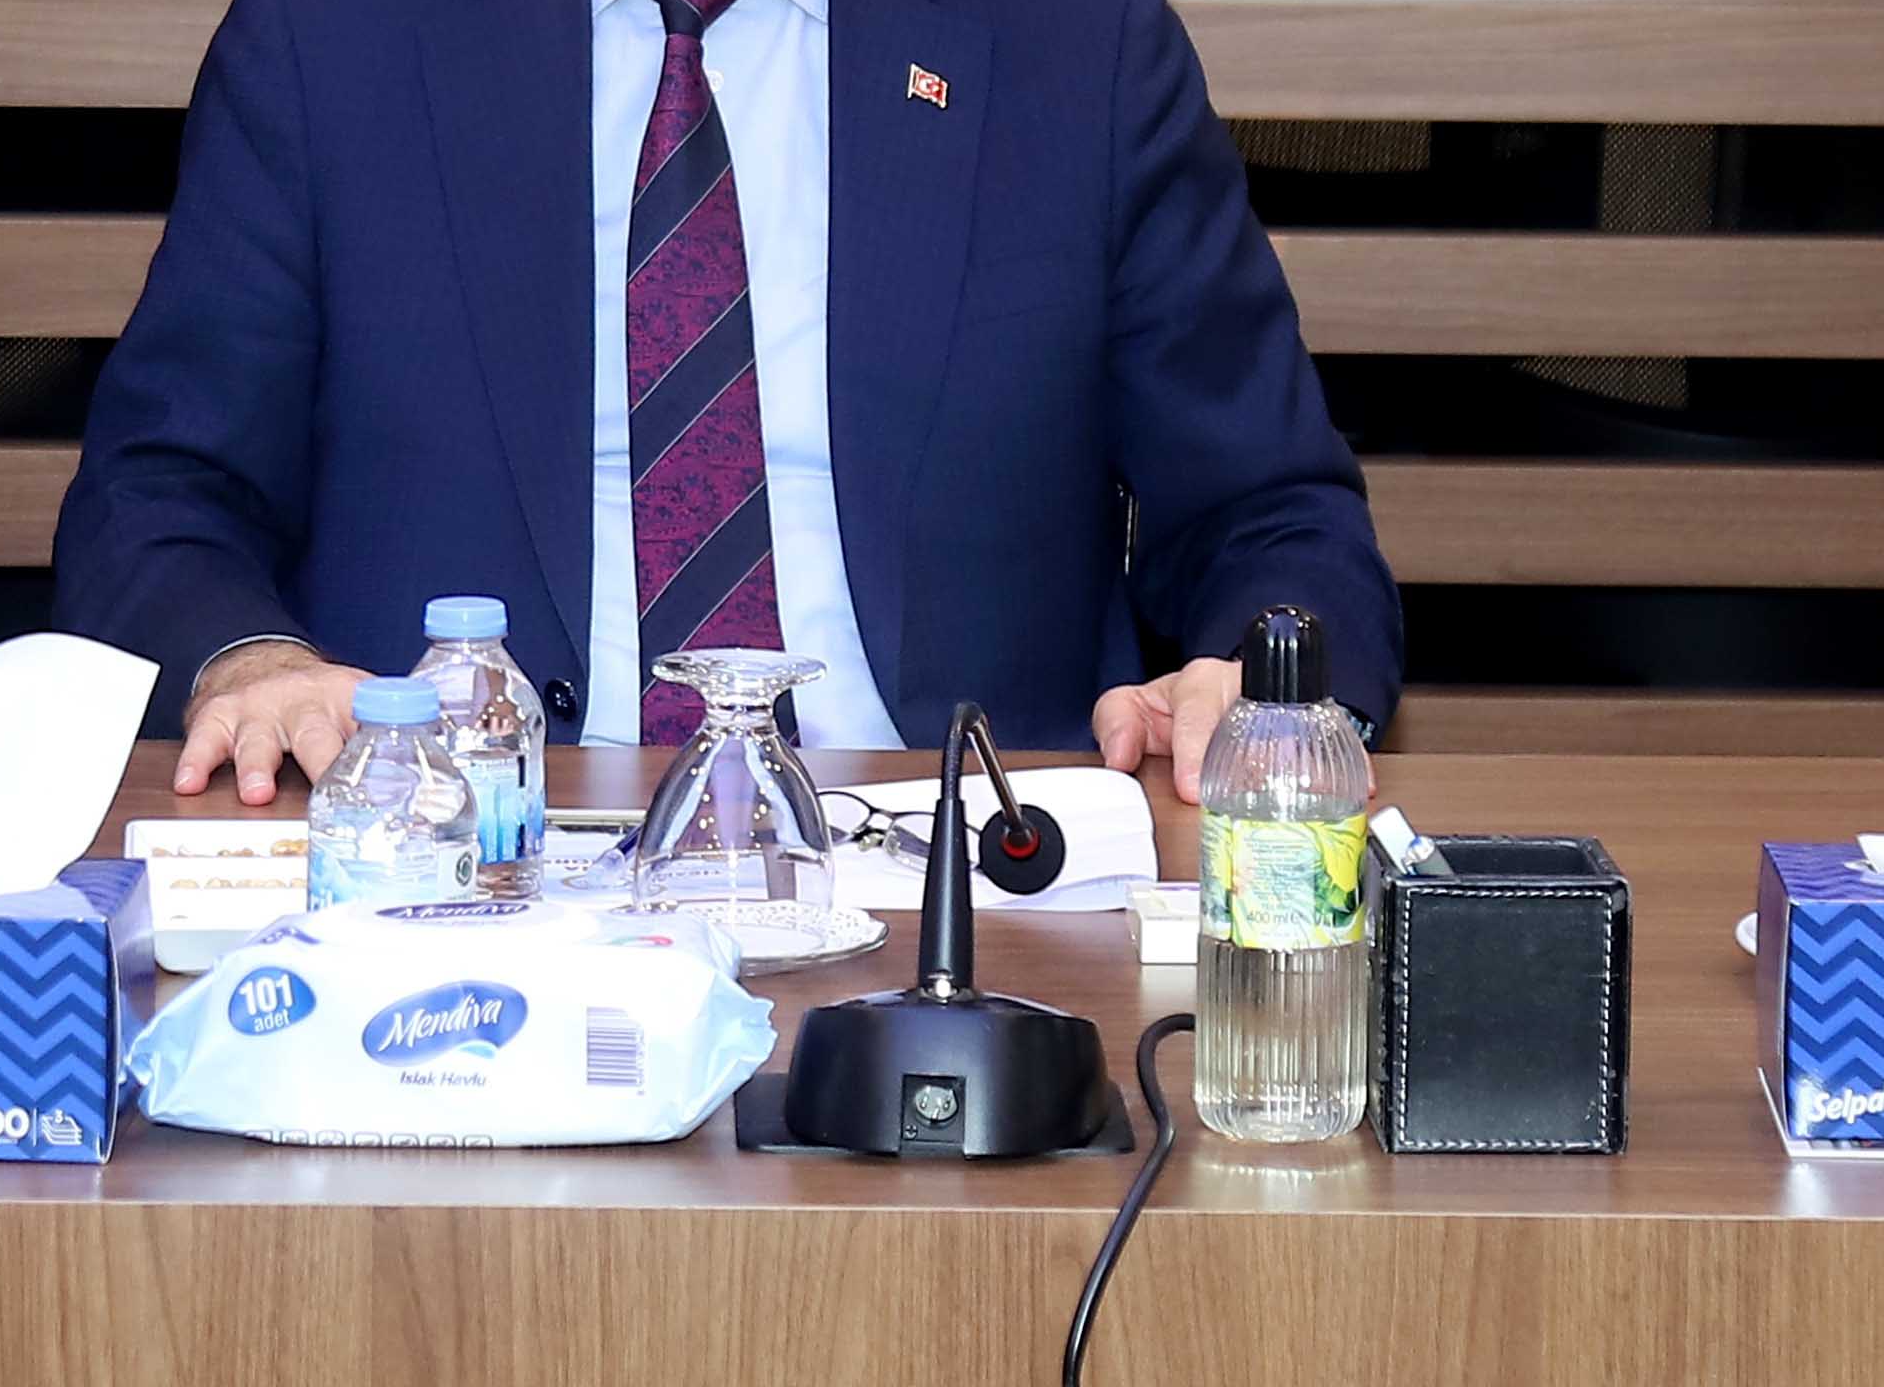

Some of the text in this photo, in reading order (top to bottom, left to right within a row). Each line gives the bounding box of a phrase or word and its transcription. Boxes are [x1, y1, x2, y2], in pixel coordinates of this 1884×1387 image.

[238, 973, 294, 1016] 101
[253, 1008, 292, 1033] adet
[377, 992, 505, 1052] Mendiva
